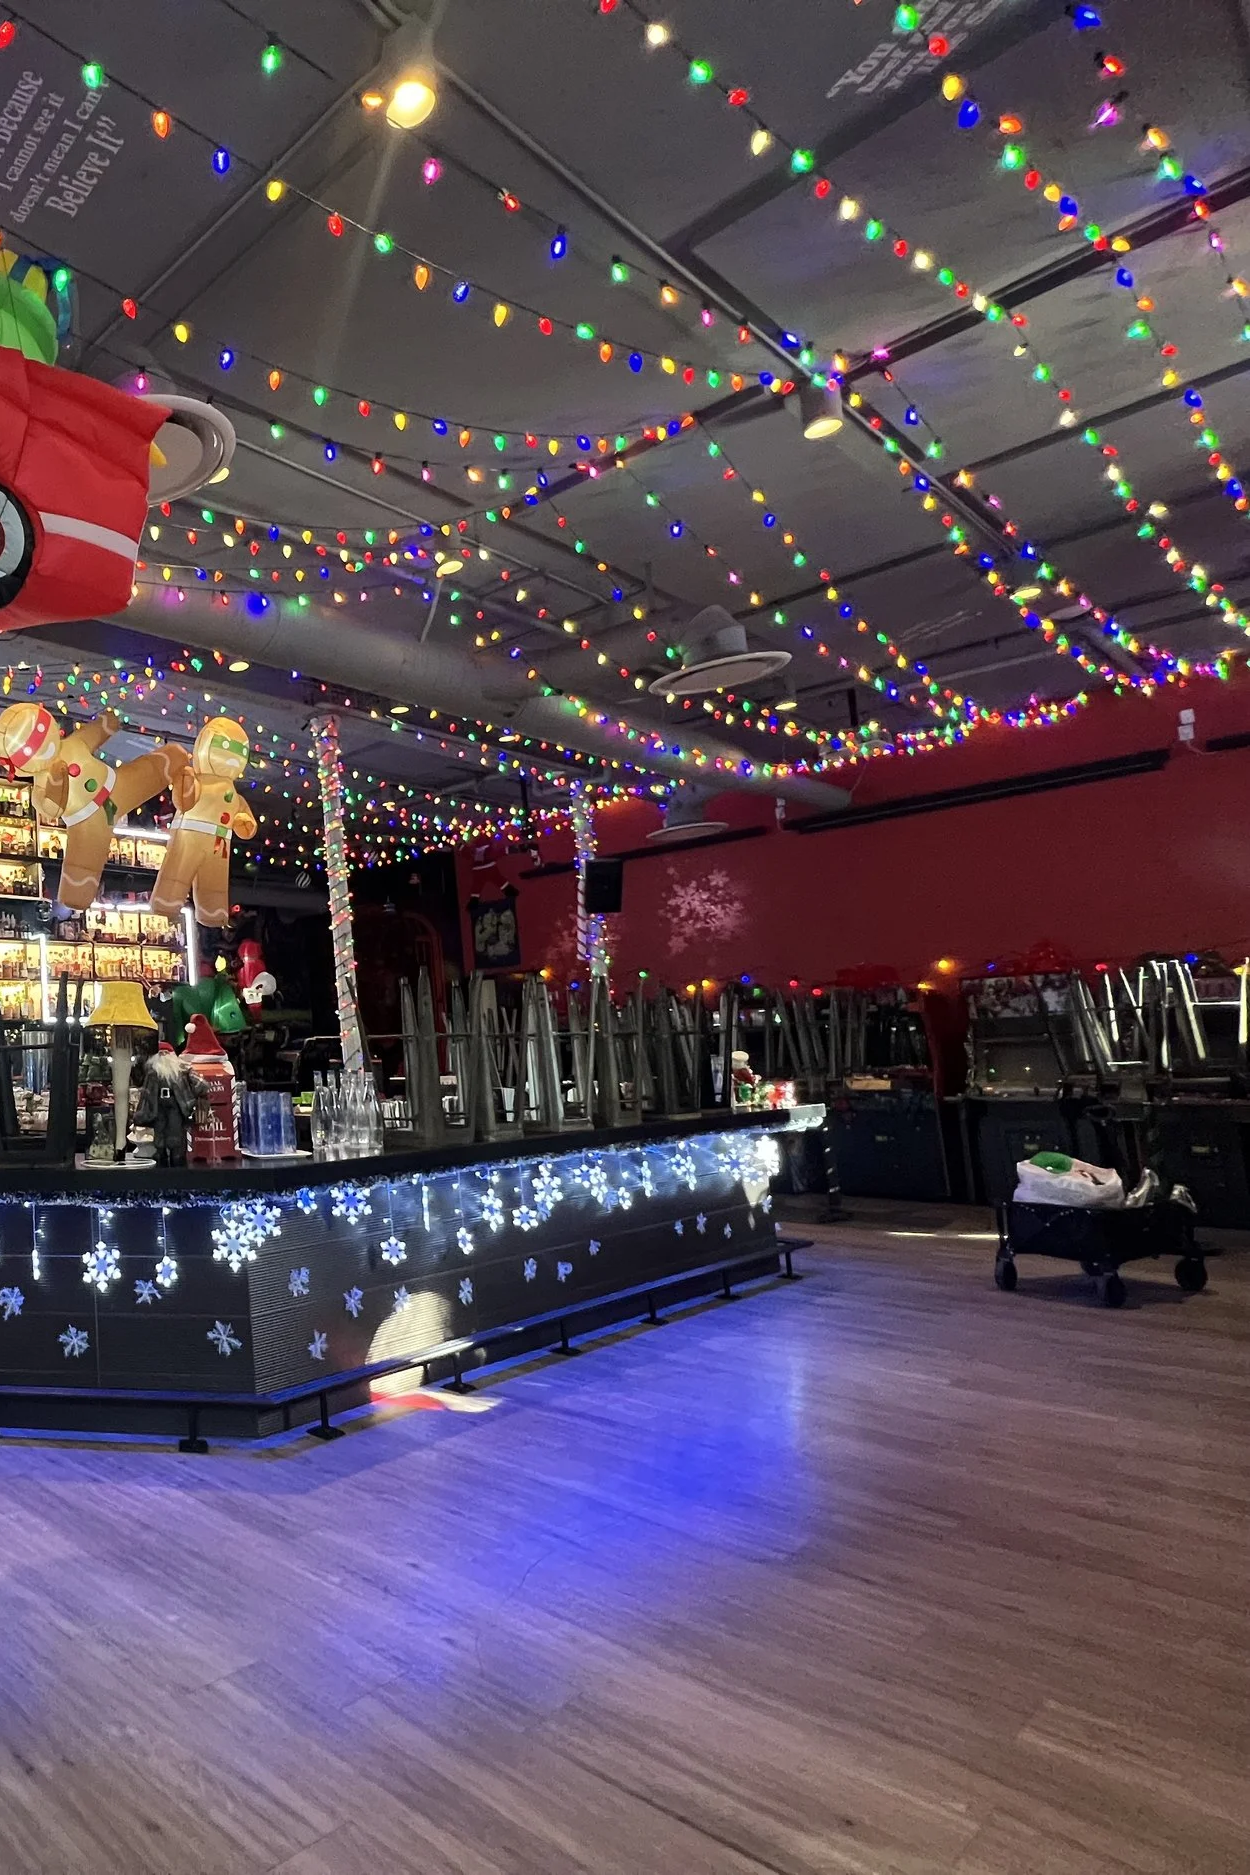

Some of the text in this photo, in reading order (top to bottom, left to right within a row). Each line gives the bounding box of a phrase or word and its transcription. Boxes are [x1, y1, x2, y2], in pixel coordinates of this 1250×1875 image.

[6, 134, 41, 182] cannot
[33, 106, 57, 136] see
[46, 91, 66, 117] it
[43, 132, 76, 173] mean
[64, 118, 84, 138] I
[44, 150, 110, 219] Believe
[199, 1121, 227, 1131] MAIL
